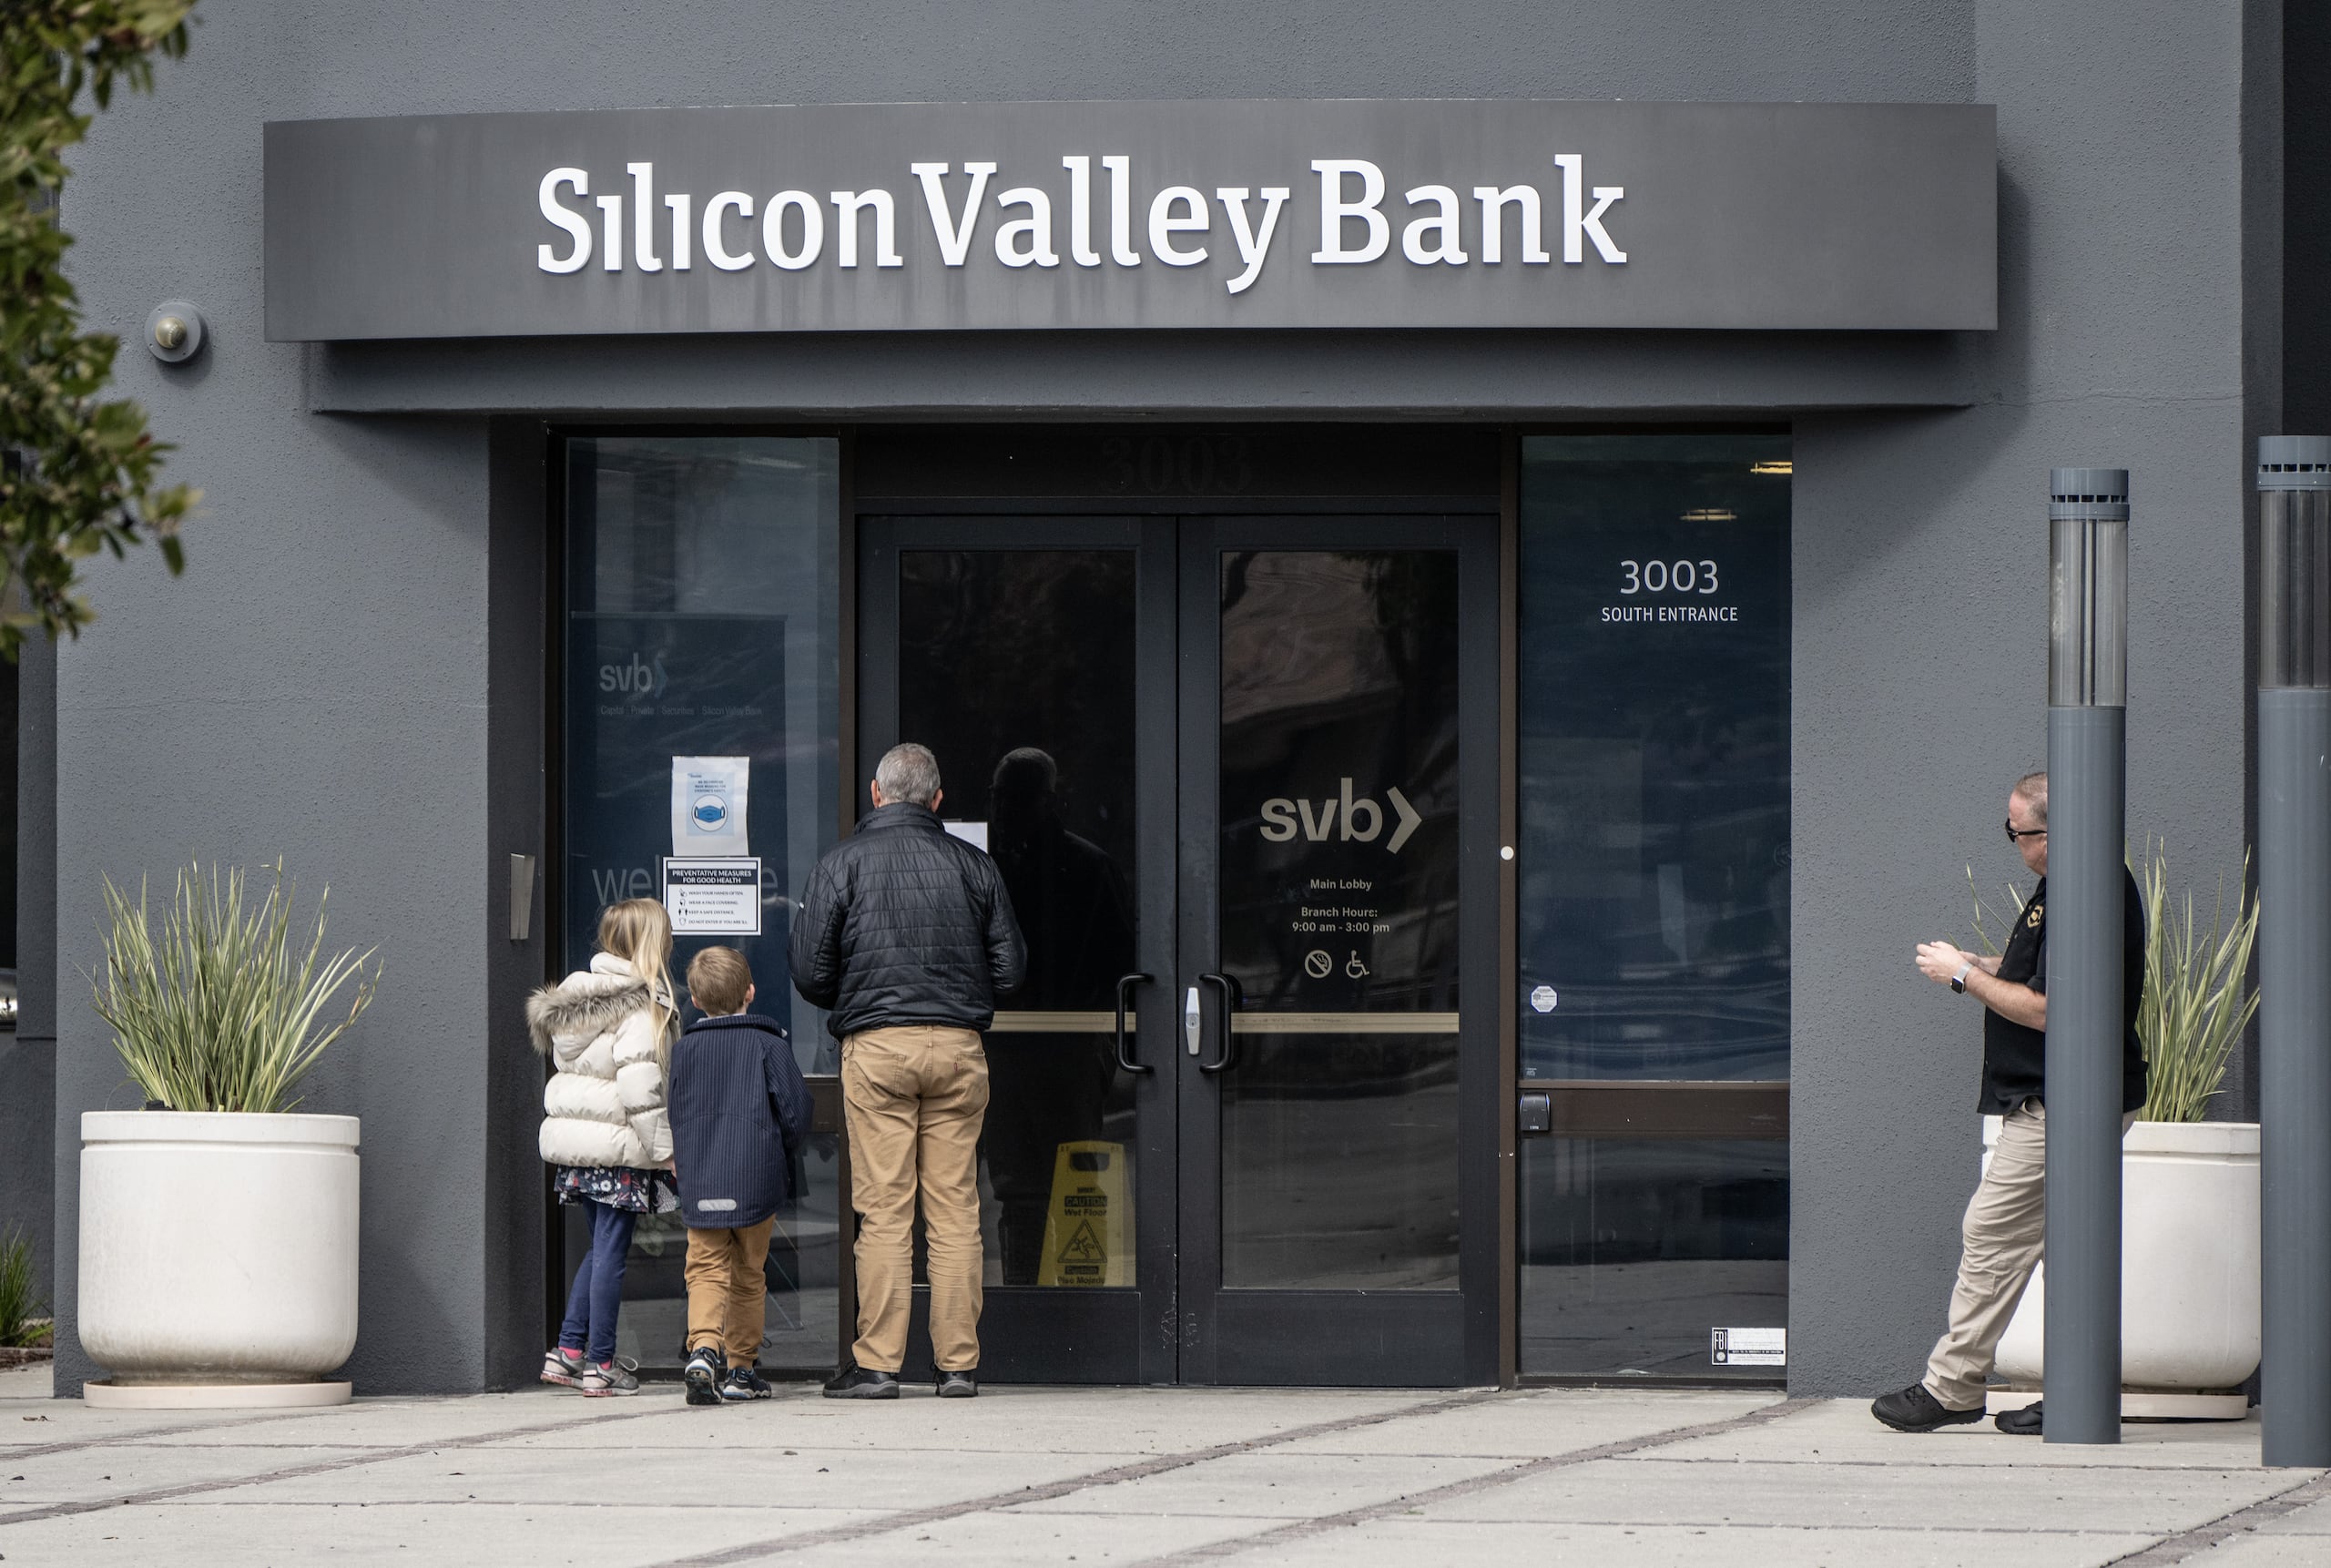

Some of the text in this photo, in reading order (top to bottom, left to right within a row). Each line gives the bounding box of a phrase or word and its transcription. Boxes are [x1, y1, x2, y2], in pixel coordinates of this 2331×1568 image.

[537, 153, 1628, 295] Silicon Valley Bank
[1620, 559, 1719, 595] 3003
[1601, 606, 1738, 622] SOUTH ENTRANCE
[599, 652, 653, 693] svb
[631, 706, 655, 716] Private
[1259, 777, 1383, 843] svb
[1310, 879, 1372, 892] Main Lobby
[1301, 906, 1378, 918] Branch Hours:
[1292, 921, 1317, 932] 9:00
[1318, 923, 1337, 932] am
[1345, 921, 1370, 932] 3:00
[1372, 923, 1390, 934] pm
[1065, 1196, 1107, 1207] CAUTION
[1064, 1208, 1107, 1217] Wet Floor
[1714, 1330, 1727, 1350] FBI
